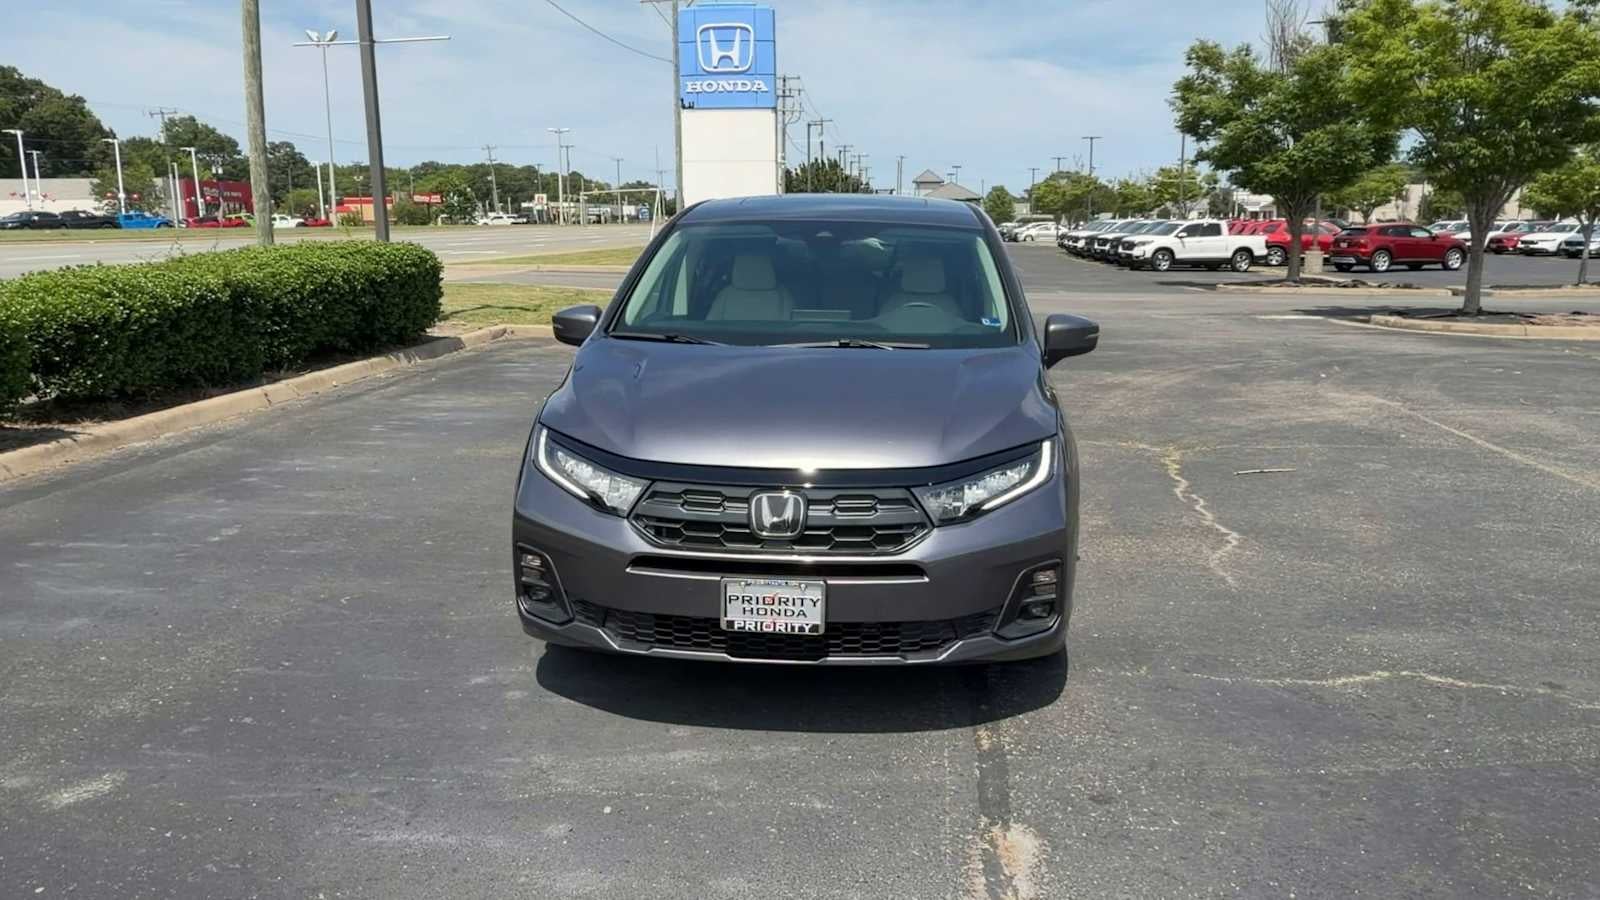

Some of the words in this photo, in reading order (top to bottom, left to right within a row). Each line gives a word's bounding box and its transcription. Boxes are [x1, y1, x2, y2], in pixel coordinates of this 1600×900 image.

[686, 80, 768, 93] HONDA
[728, 594, 820, 607] PRIORITY
[743, 607, 808, 618] HONDA
[734, 621, 812, 633] PRIORITY
